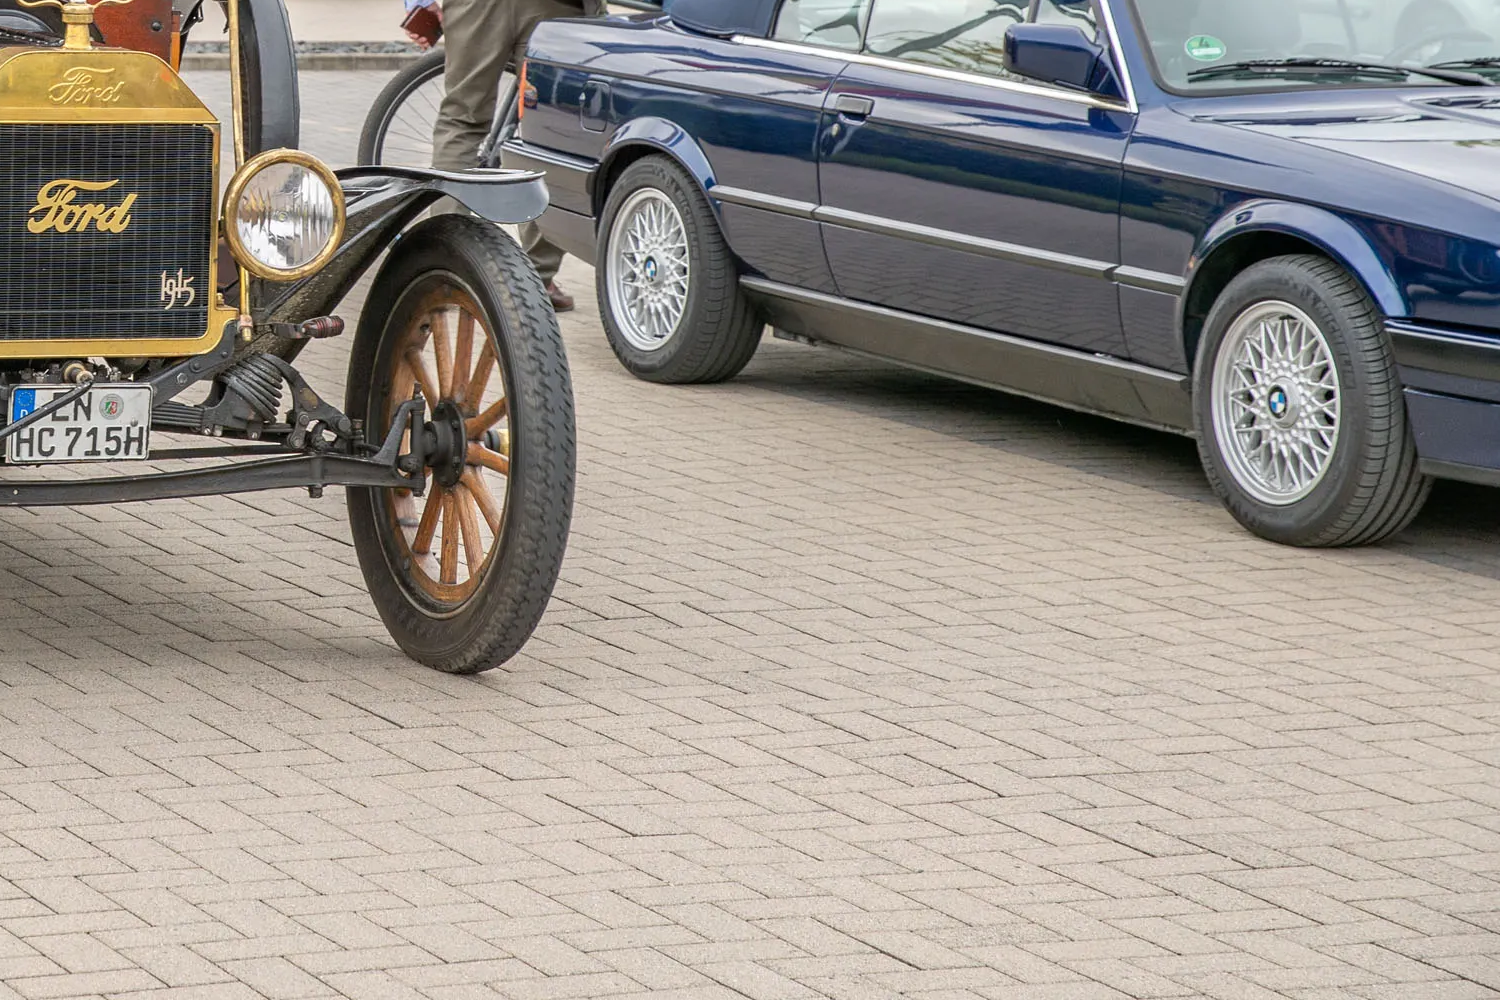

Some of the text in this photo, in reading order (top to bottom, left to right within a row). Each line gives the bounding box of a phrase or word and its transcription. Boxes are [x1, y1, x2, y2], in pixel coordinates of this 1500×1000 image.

[48, 66, 125, 105] Ford
[27, 178, 138, 234] Ford
[160, 267, 196, 310] 1915
[51, 391, 93, 422] EN
[15, 426, 144, 458] HC 715H
